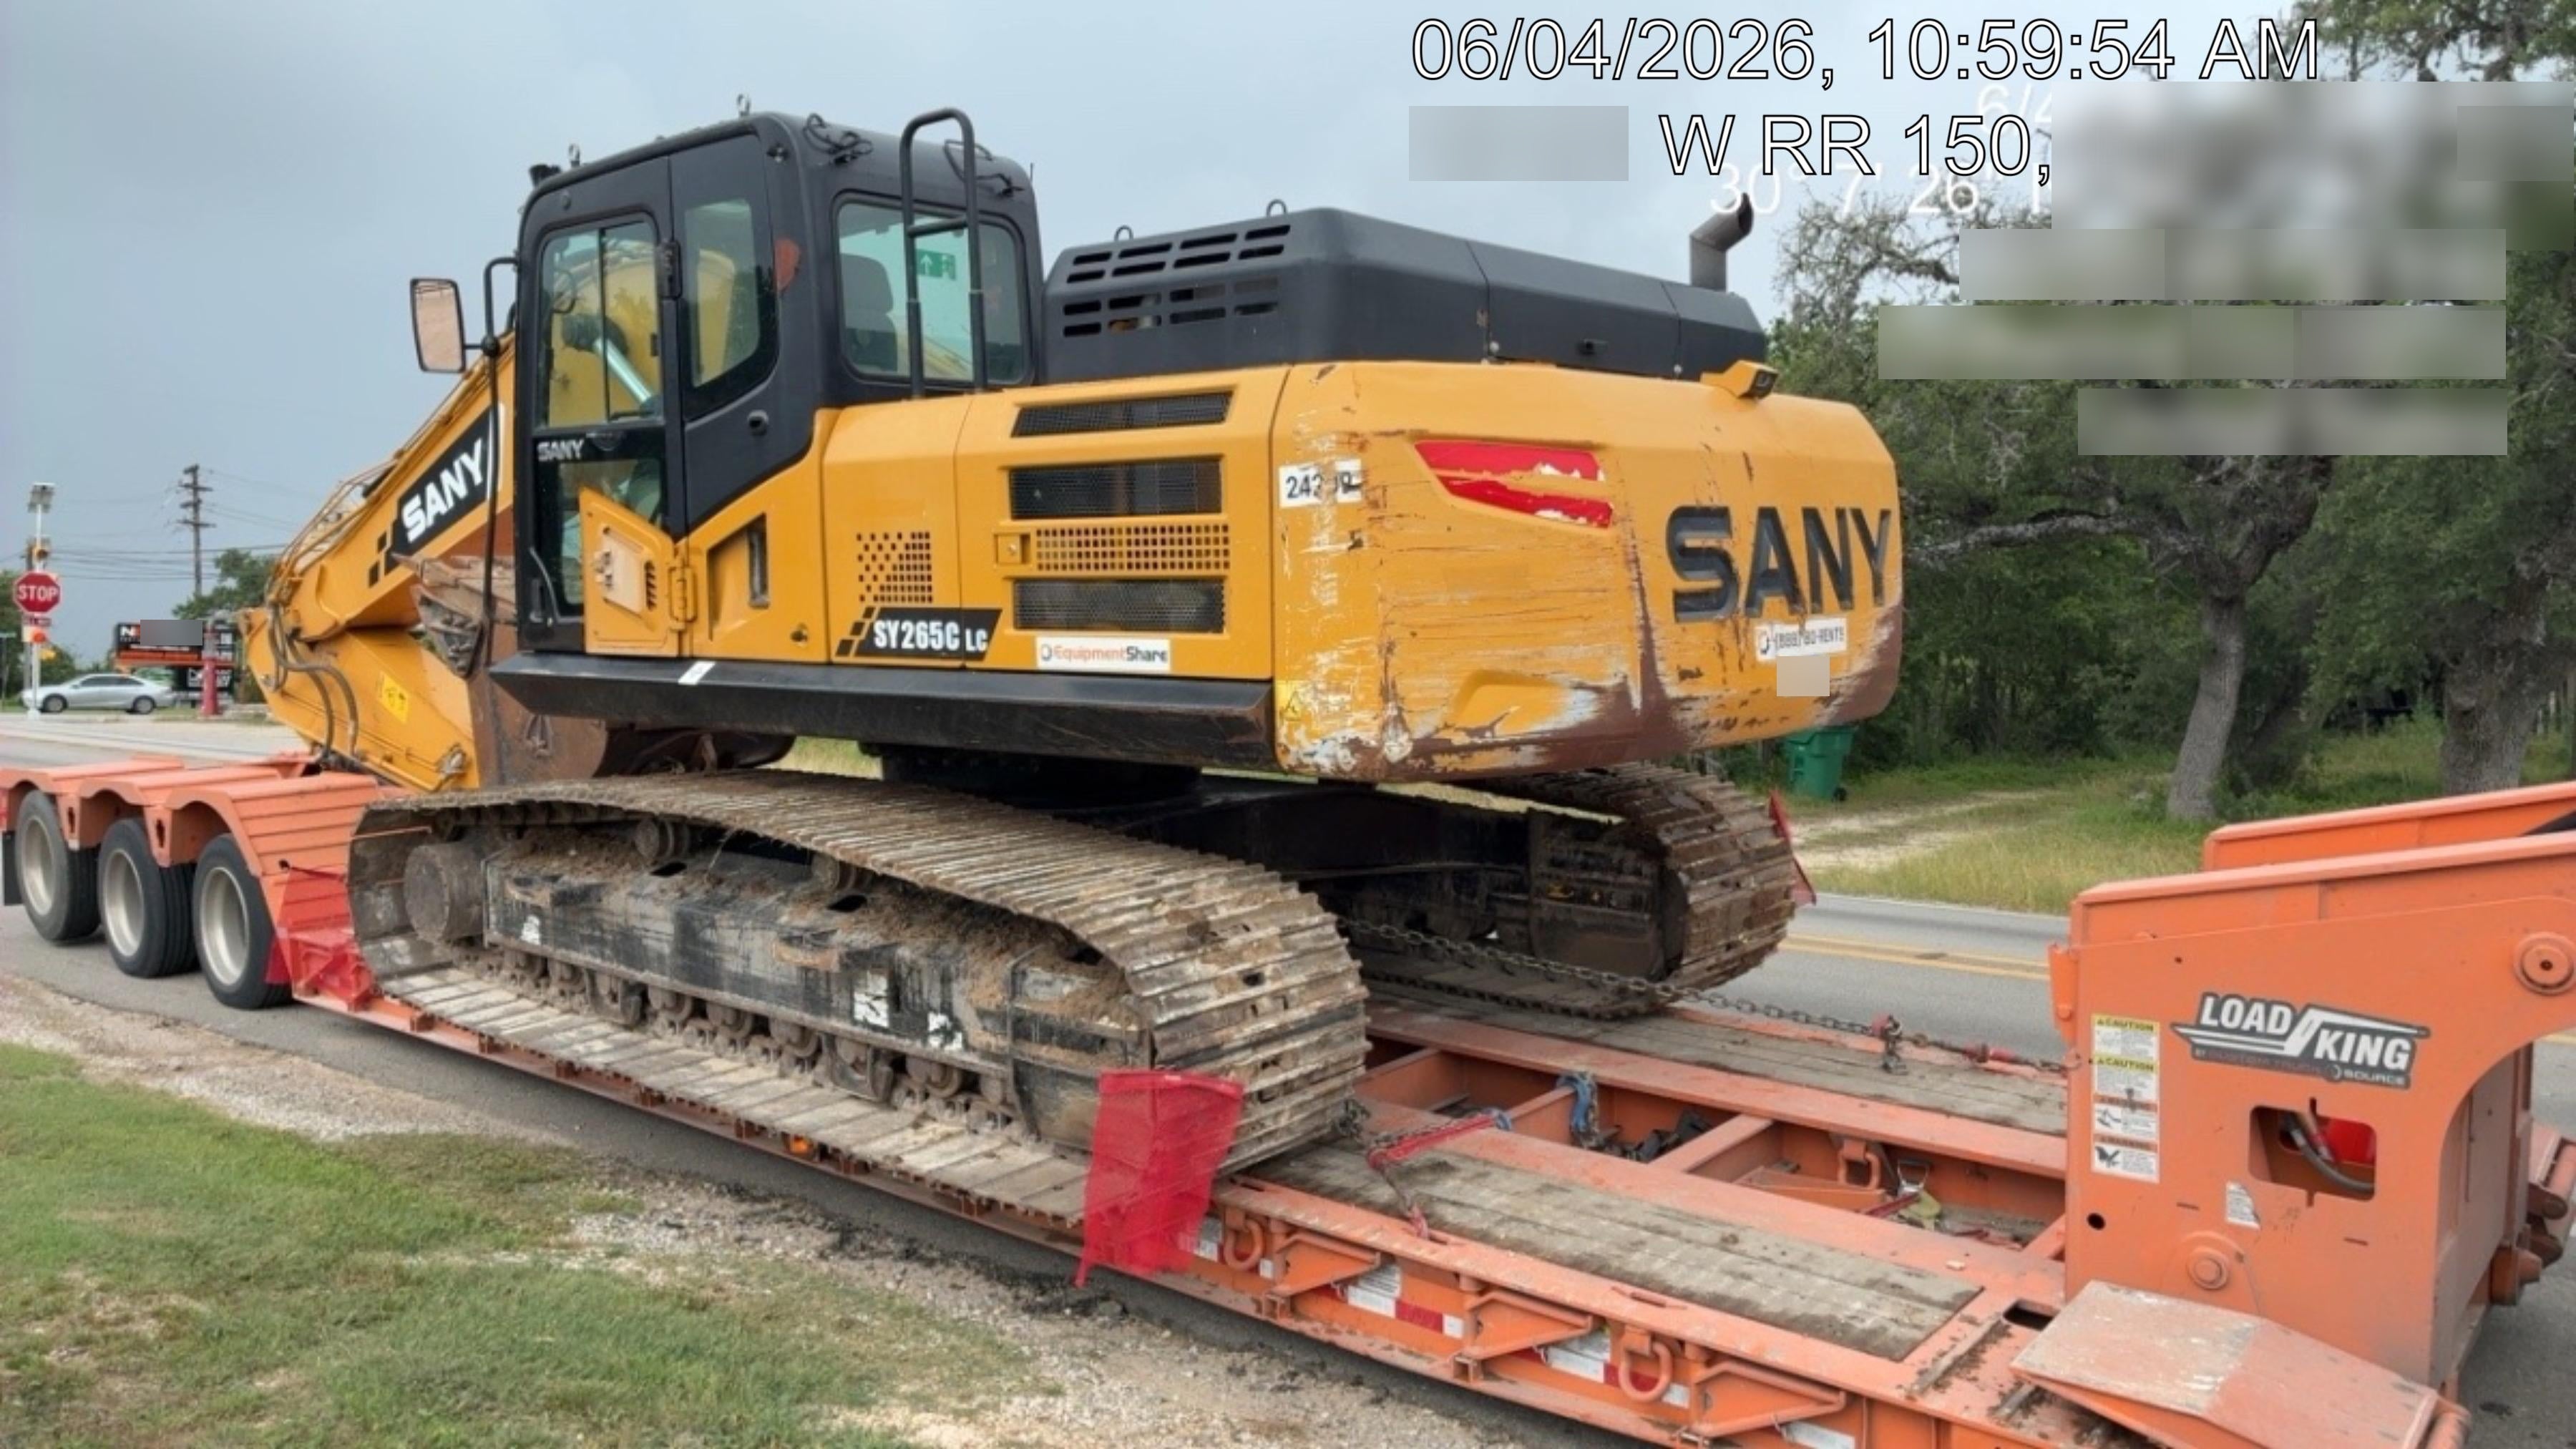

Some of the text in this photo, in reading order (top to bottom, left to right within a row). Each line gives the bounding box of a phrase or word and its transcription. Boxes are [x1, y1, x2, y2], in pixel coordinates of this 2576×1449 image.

[537, 438, 585, 462] SANY
[401, 437, 484, 544] SANY
[1665, 505, 1892, 623] SANY
[18, 584, 59, 602] STOP
[872, 619, 988, 652] SY265C LC
[1053, 645, 1169, 663] EquipmentShare
[2105, 1018, 2154, 1032] CAUTION
[2199, 995, 2412, 1072] LOAD KING
[2105, 1058, 2154, 1072] CAUTION
